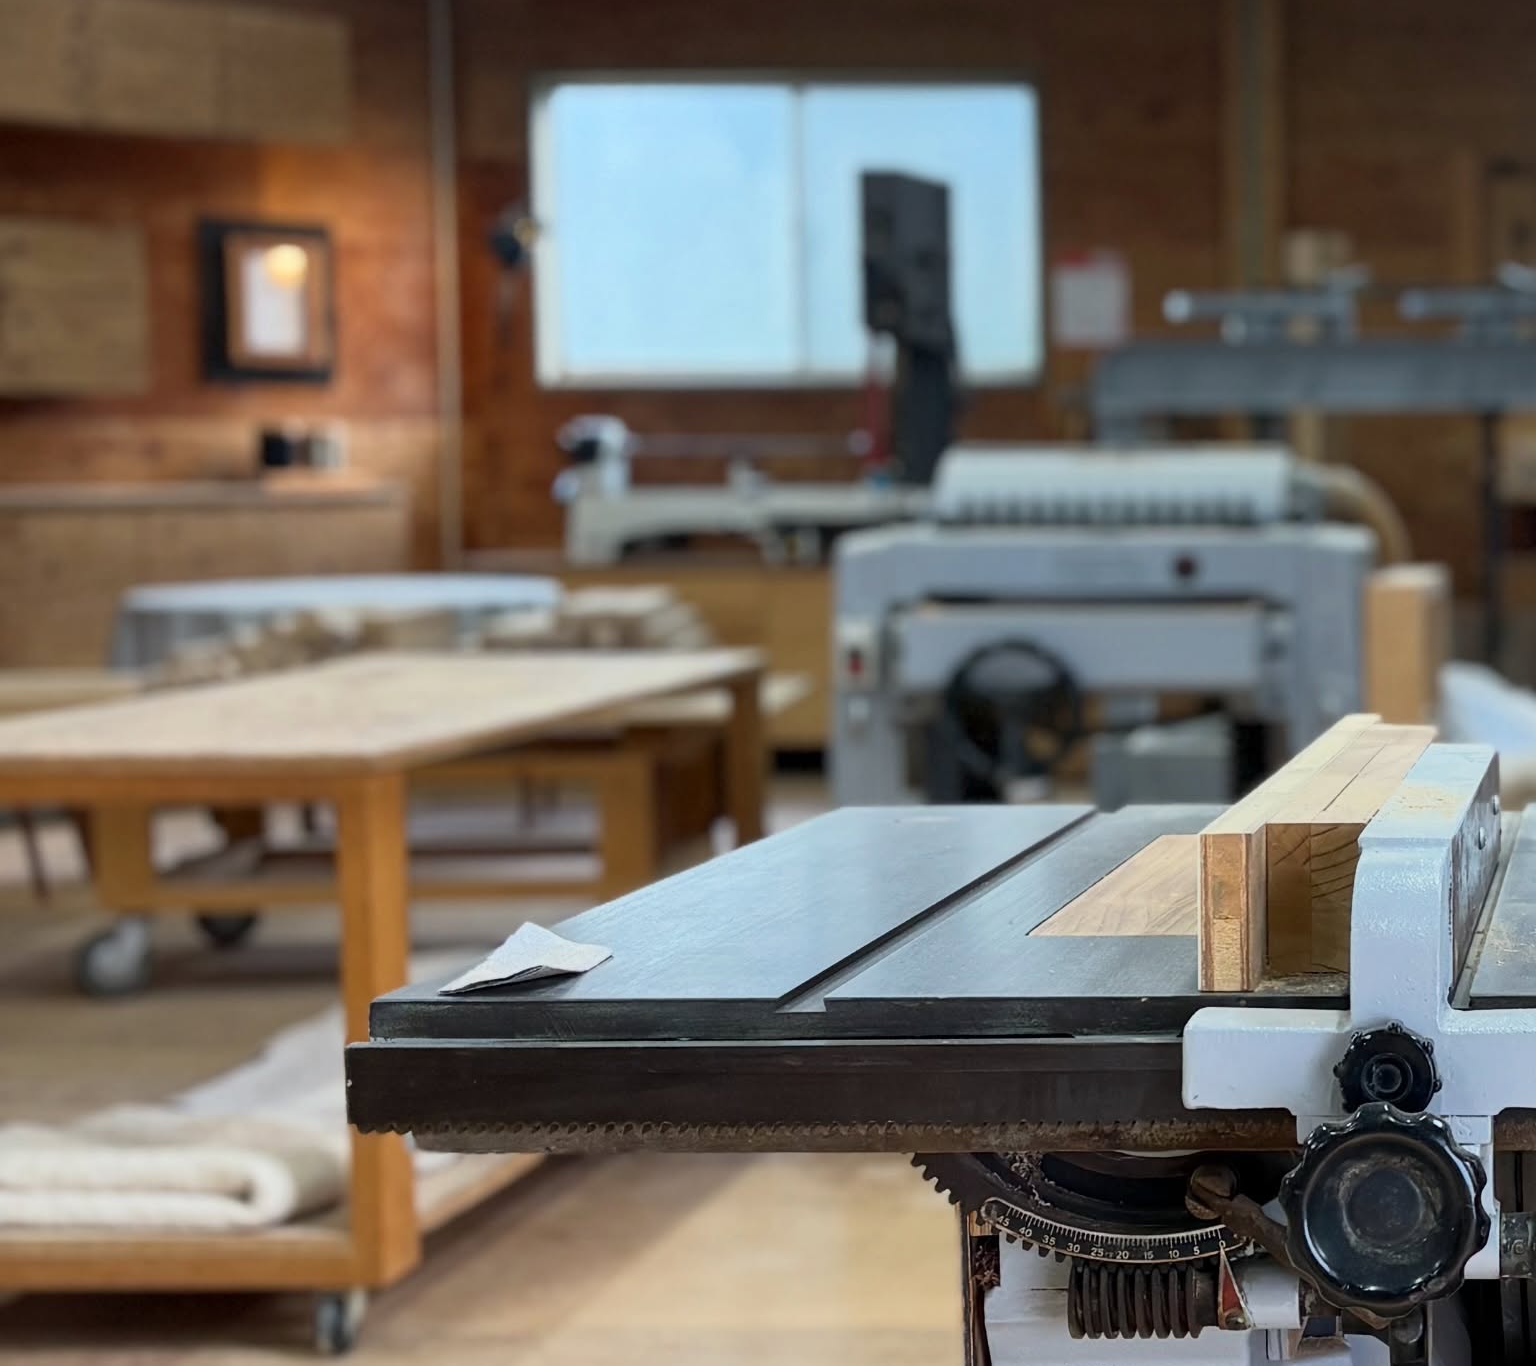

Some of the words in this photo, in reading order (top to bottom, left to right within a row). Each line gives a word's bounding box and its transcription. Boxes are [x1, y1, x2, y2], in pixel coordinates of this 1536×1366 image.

[997, 1215, 1010, 1227] 45
[1019, 1227, 1033, 1237] 40
[1042, 1235, 1056, 1246] 35
[1066, 1242, 1080, 1253] 30
[1090, 1247, 1104, 1257] 25
[1116, 1250, 1129, 1260] 20
[1144, 1250, 1154, 1260] 15
[1169, 1249, 1180, 1259] 10
[1193, 1246, 1200, 1256] 5
